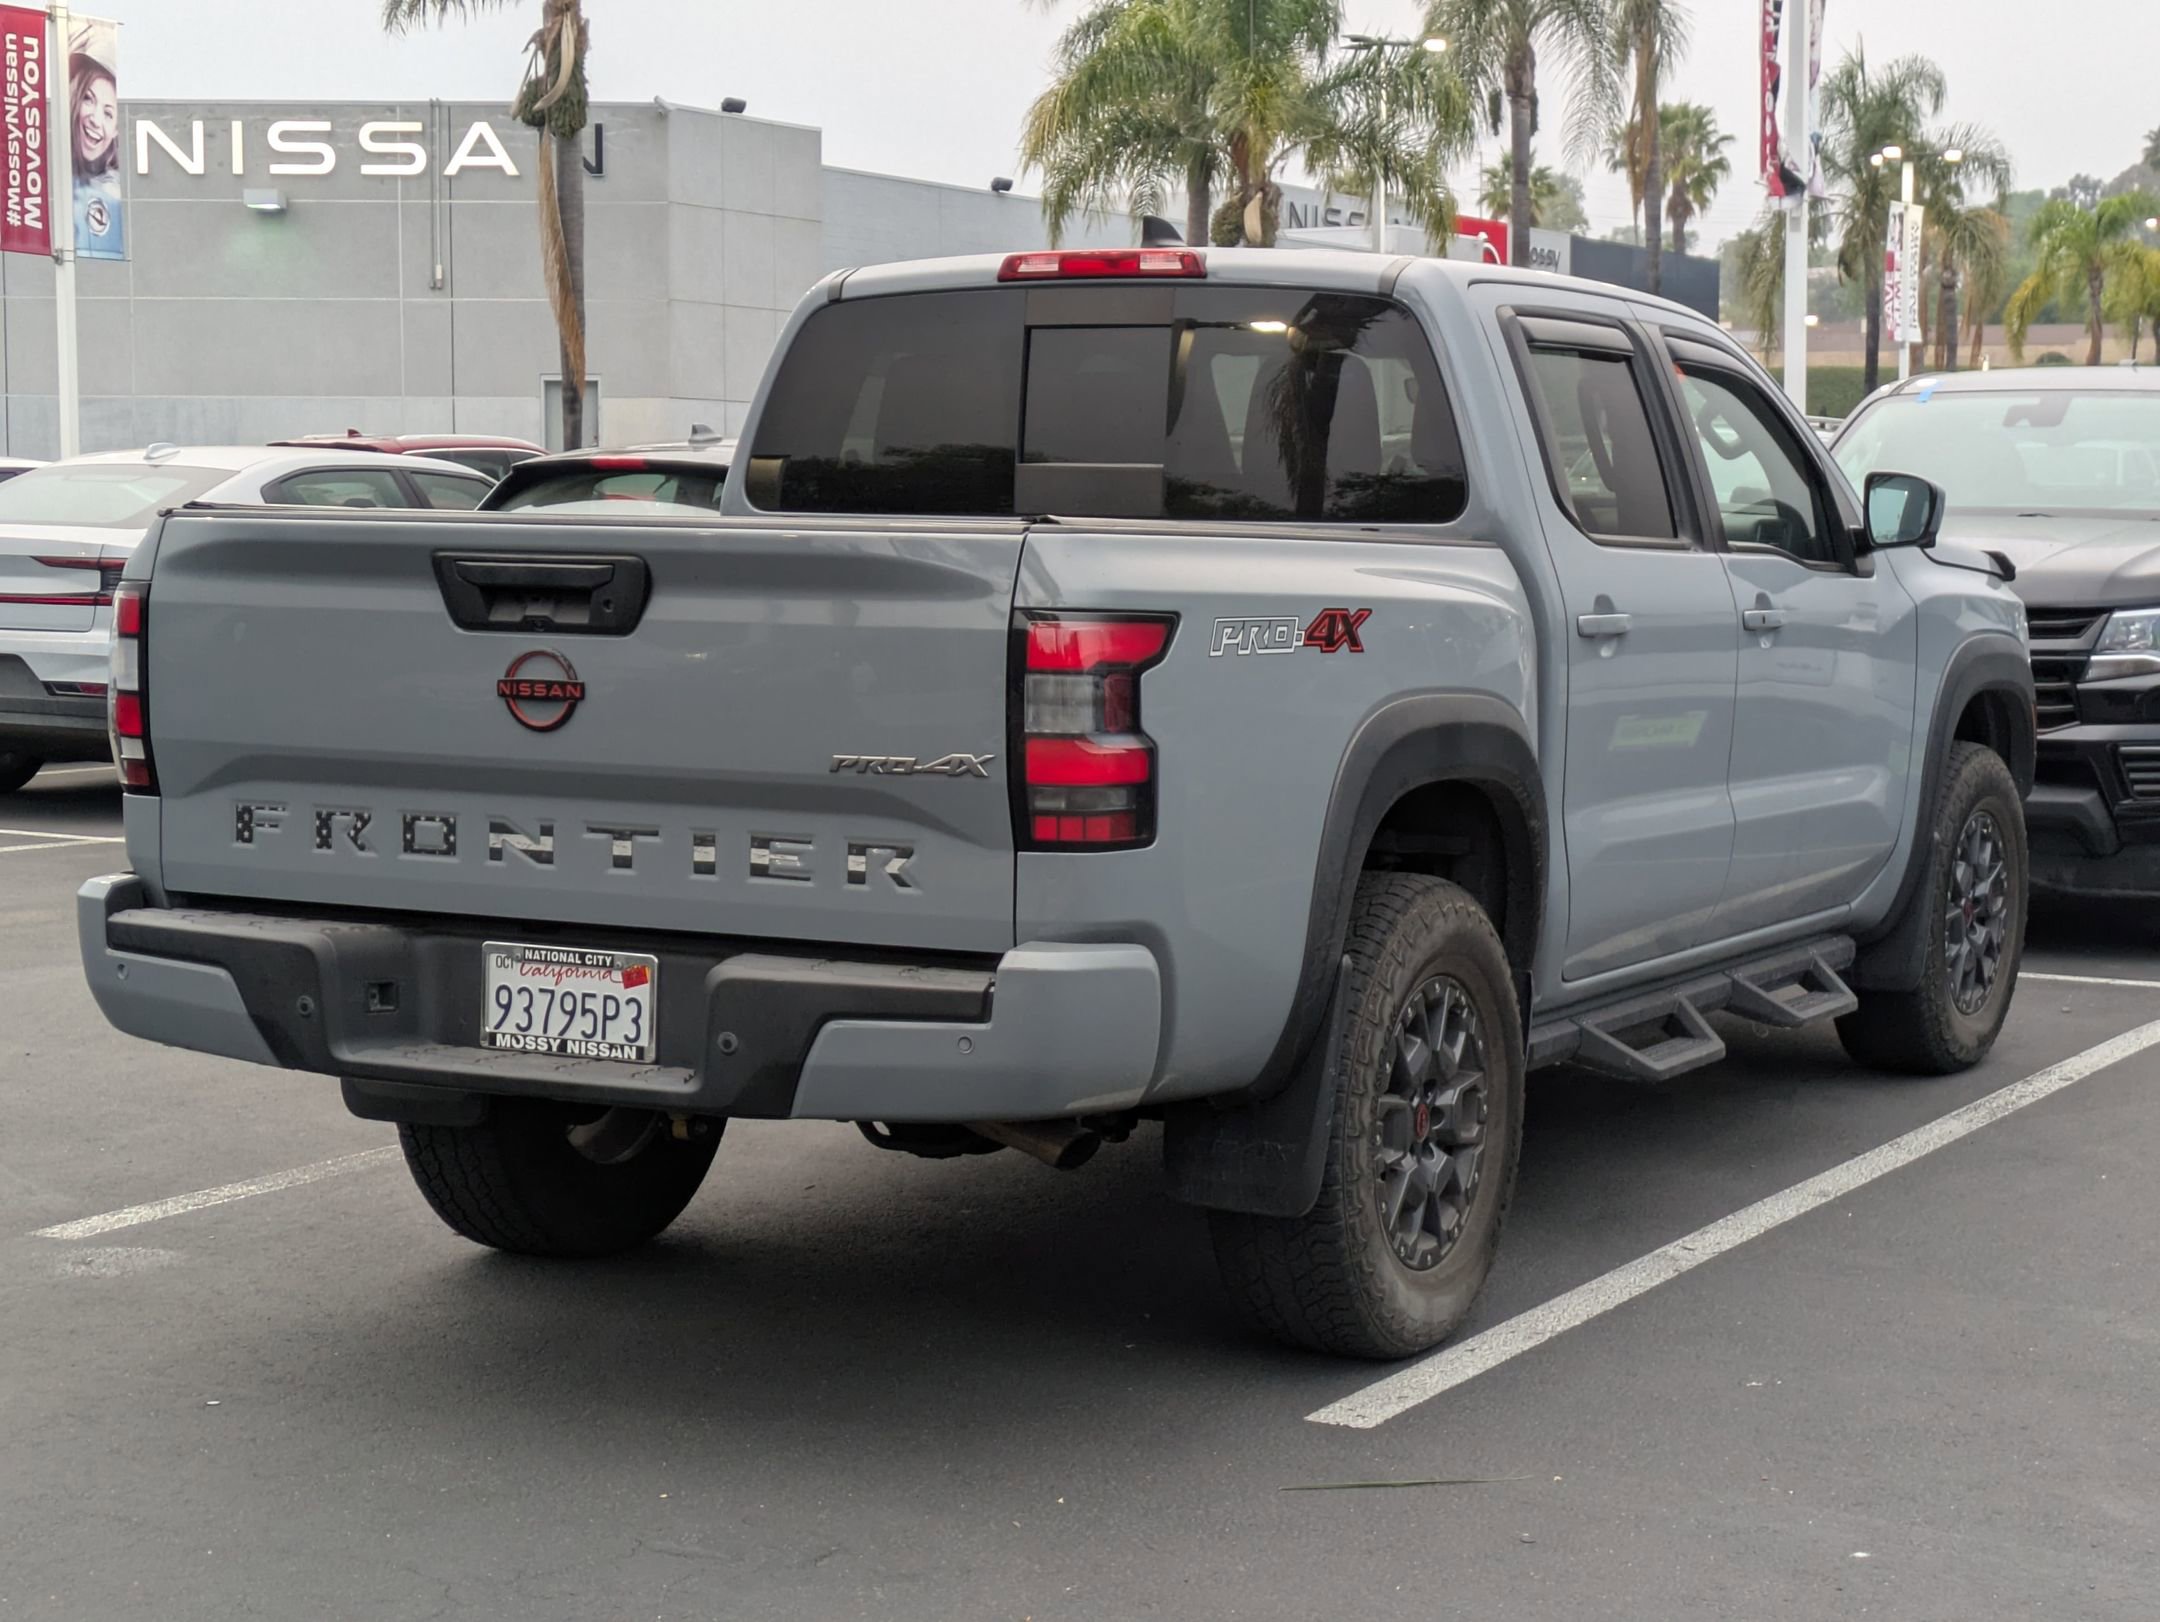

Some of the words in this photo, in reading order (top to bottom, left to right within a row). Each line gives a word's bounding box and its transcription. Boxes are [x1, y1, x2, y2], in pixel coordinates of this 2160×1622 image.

[5, 32, 22, 227] #MossyNissan
[22, 36, 43, 229] MovesYou
[1288, 201, 1412, 229] NISS
[1530, 247, 1561, 273] ossy
[499, 682, 582, 698] NISSAN
[234, 802, 918, 891] FRONTIER
[524, 949, 581, 964] NATIONAL
[585, 954, 613, 967] CITY
[519, 961, 625, 986] California
[494, 984, 643, 1044] 93795P3
[496, 1033, 561, 1052] MOSSY
[567, 1037, 637, 1060] NISSAN
